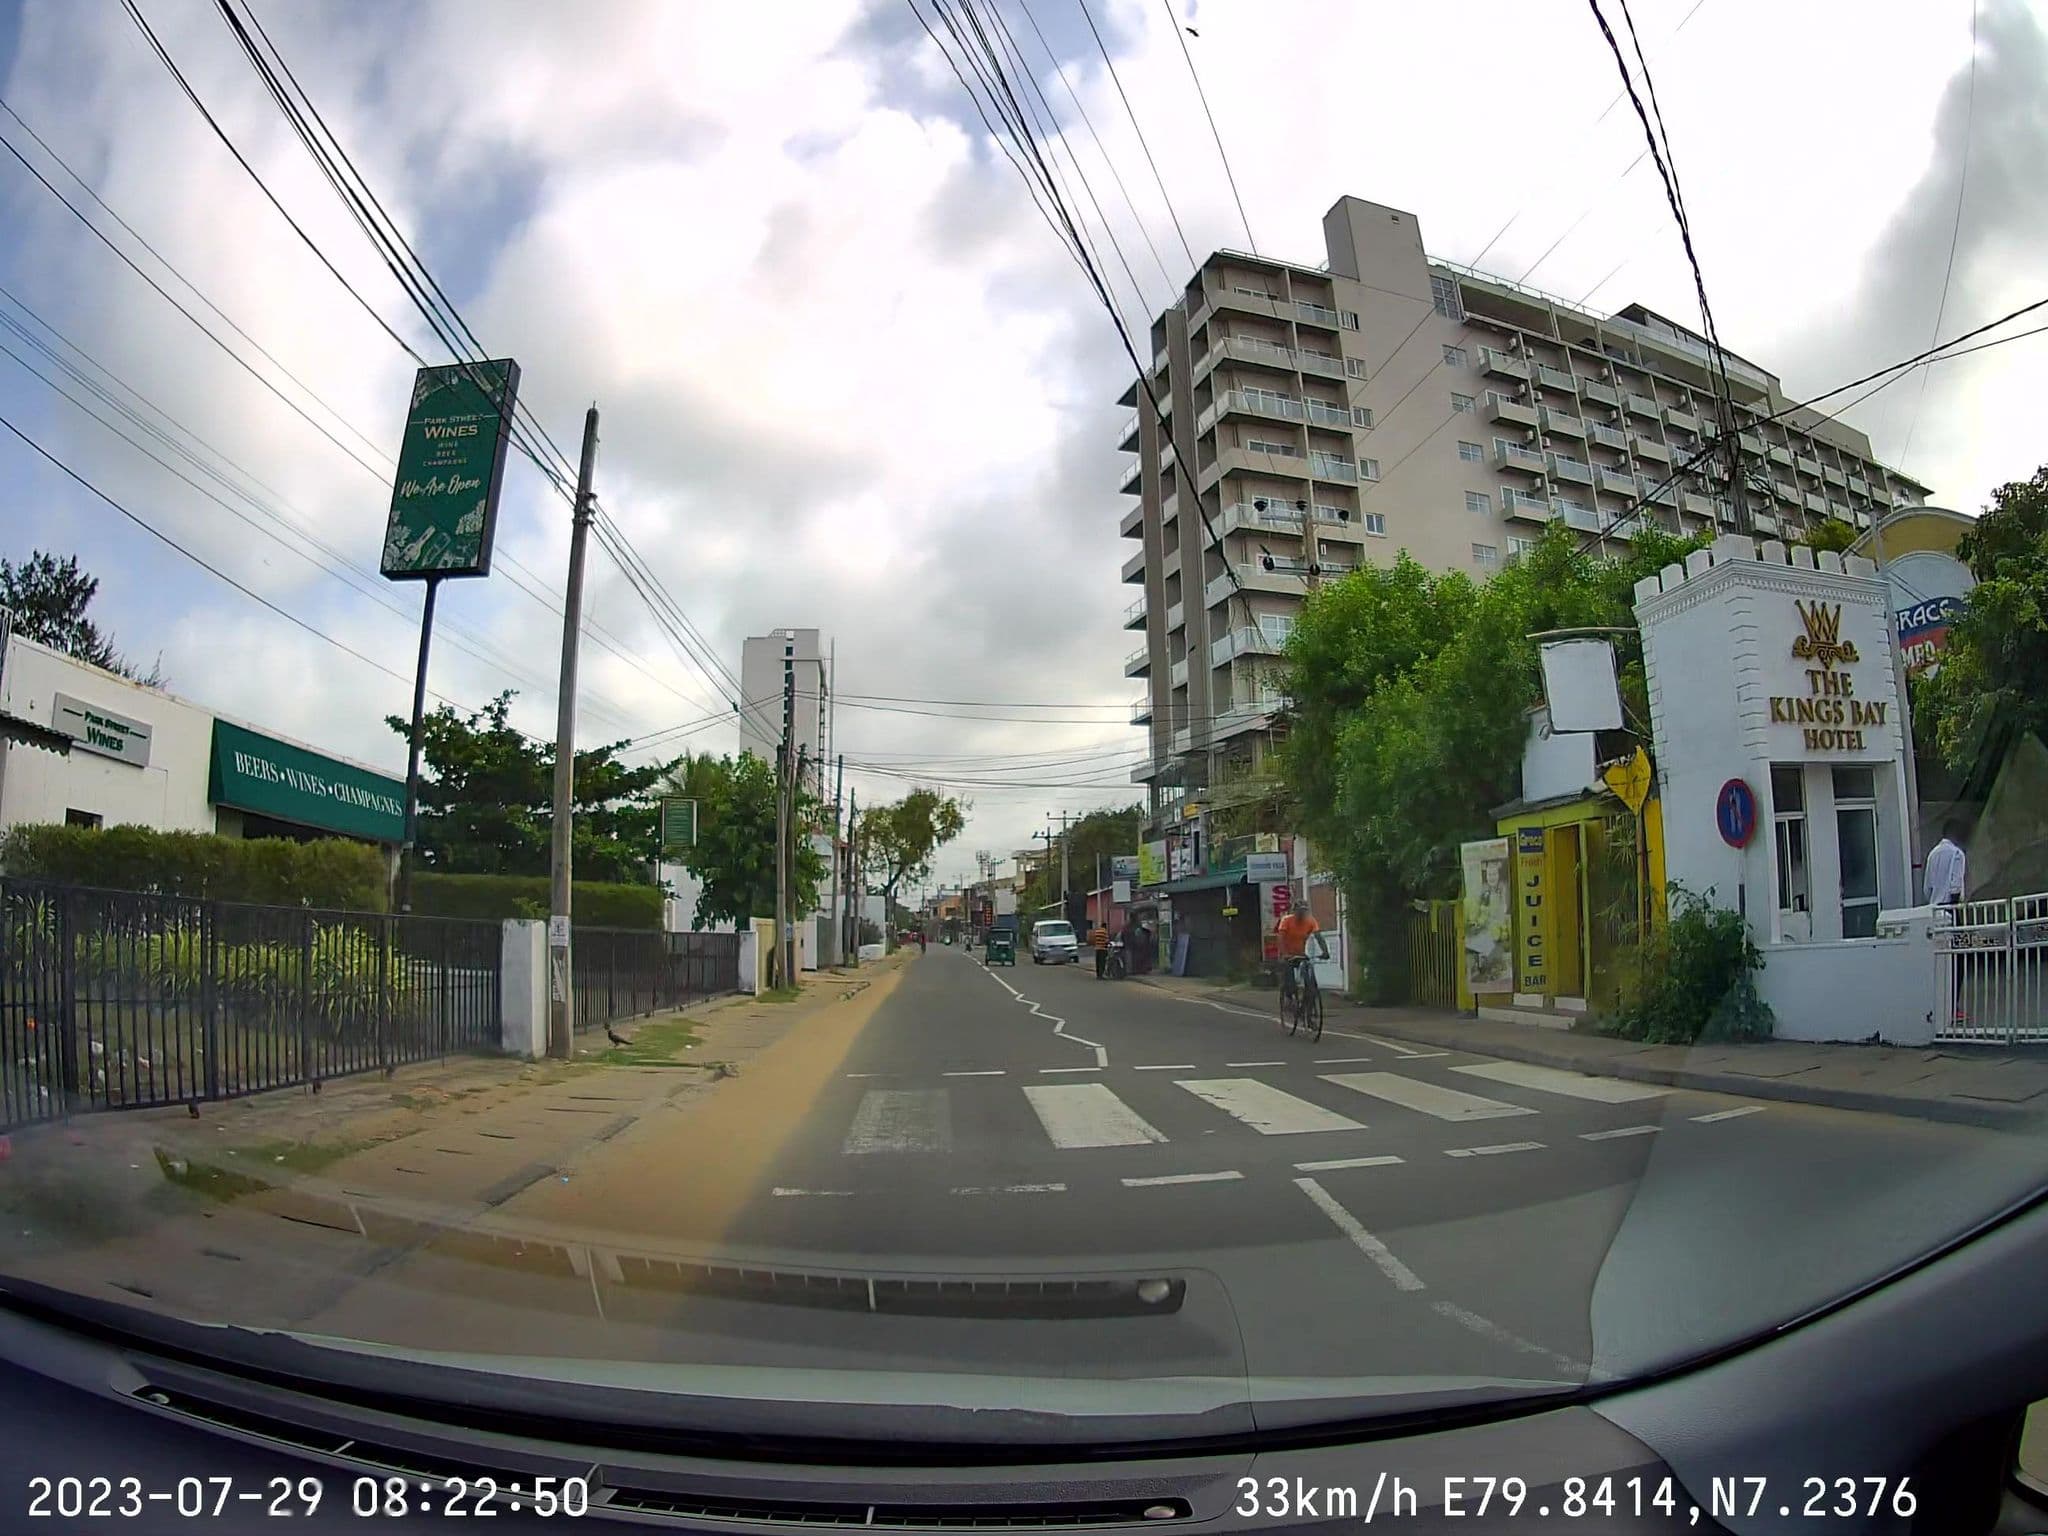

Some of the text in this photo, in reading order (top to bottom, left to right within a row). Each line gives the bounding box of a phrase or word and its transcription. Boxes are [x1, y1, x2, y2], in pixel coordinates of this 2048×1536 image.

[424, 425, 478, 440] WINES
[400, 473, 481, 498] We Are Open
[1805, 669, 1854, 697] THE
[1769, 697, 1888, 726] KINGS BAY
[86, 726, 124, 752] WINES
[1803, 729, 1867, 750] HOTEL
[234, 751, 403, 817] BEERS WINES CHAMPAGNES
[1525, 874, 1543, 967] JUICE
[1525, 975, 1547, 987] BAR
